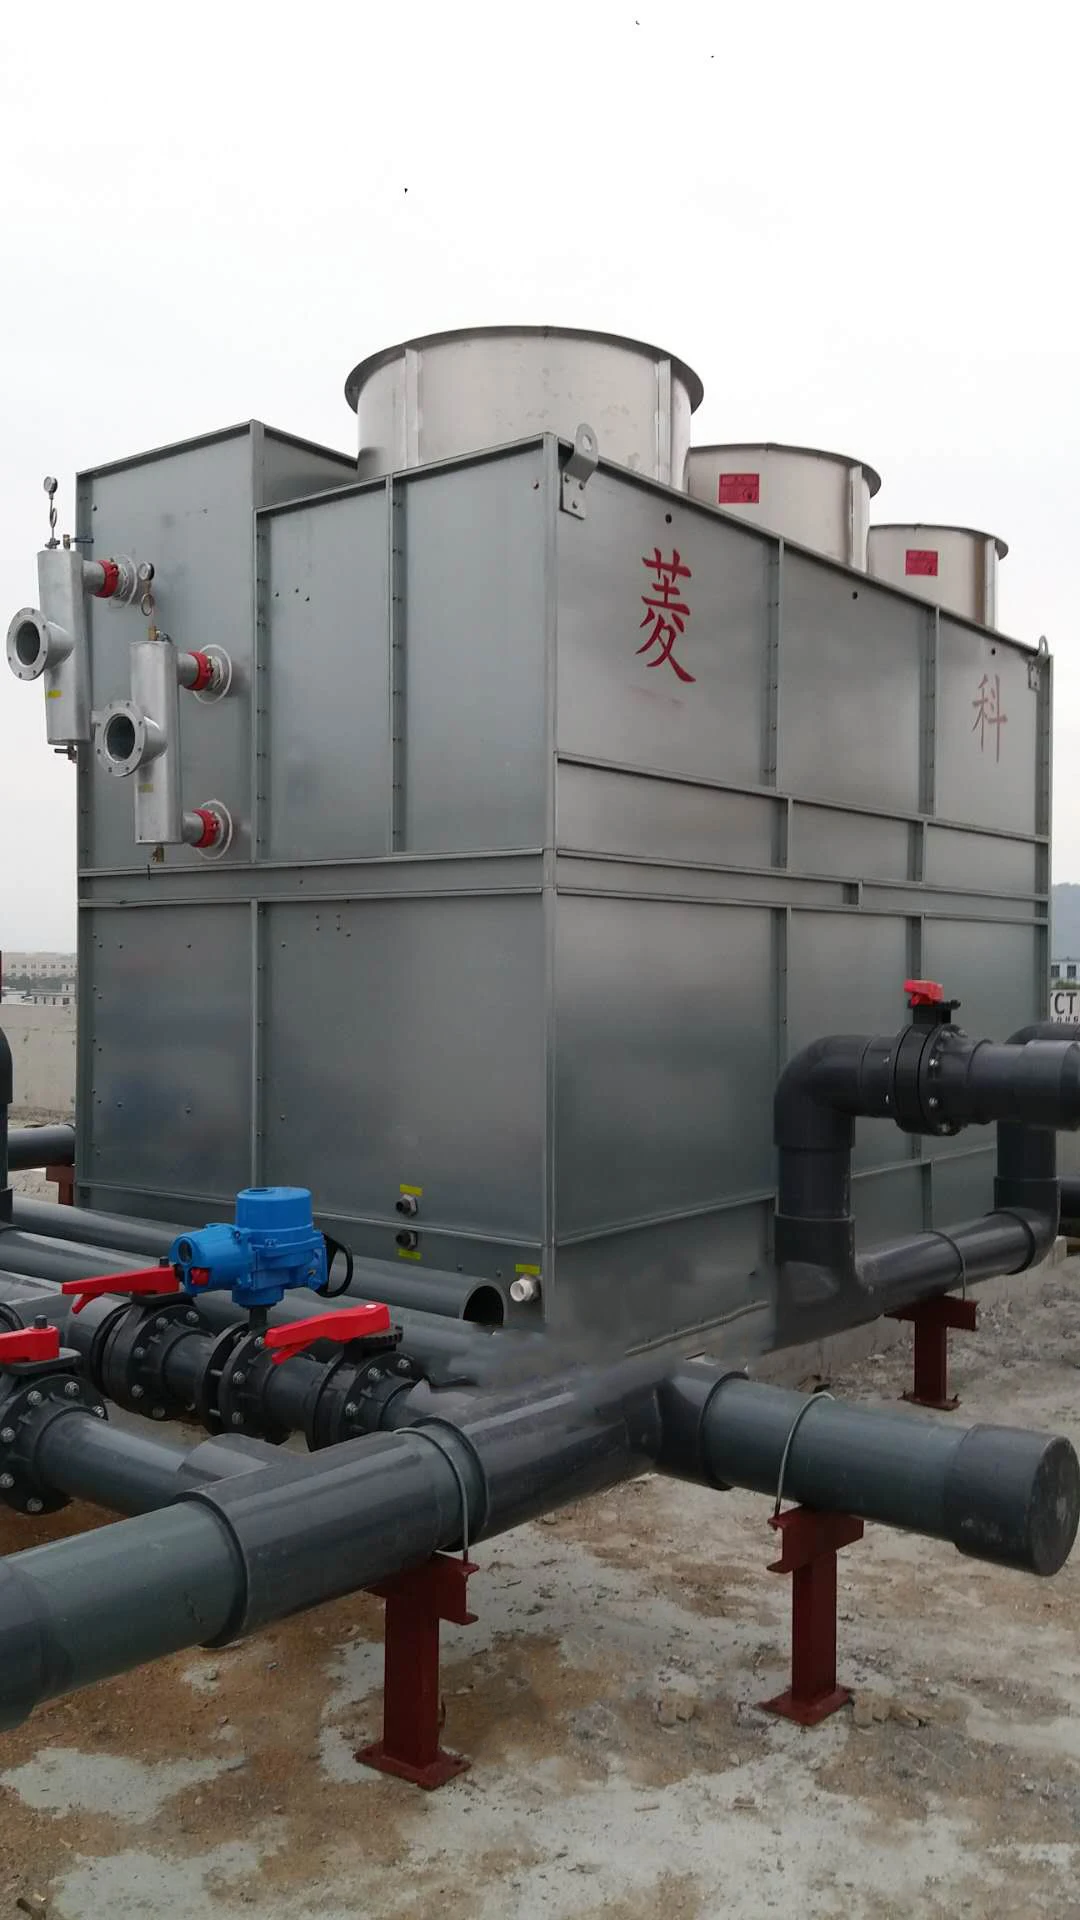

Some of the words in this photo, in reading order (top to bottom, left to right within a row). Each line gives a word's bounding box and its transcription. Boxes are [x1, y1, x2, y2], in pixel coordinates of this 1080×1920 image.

[635, 547, 697, 683] 菱
[971, 673, 1008, 764] 科
[1050, 992, 1078, 1015] CT
